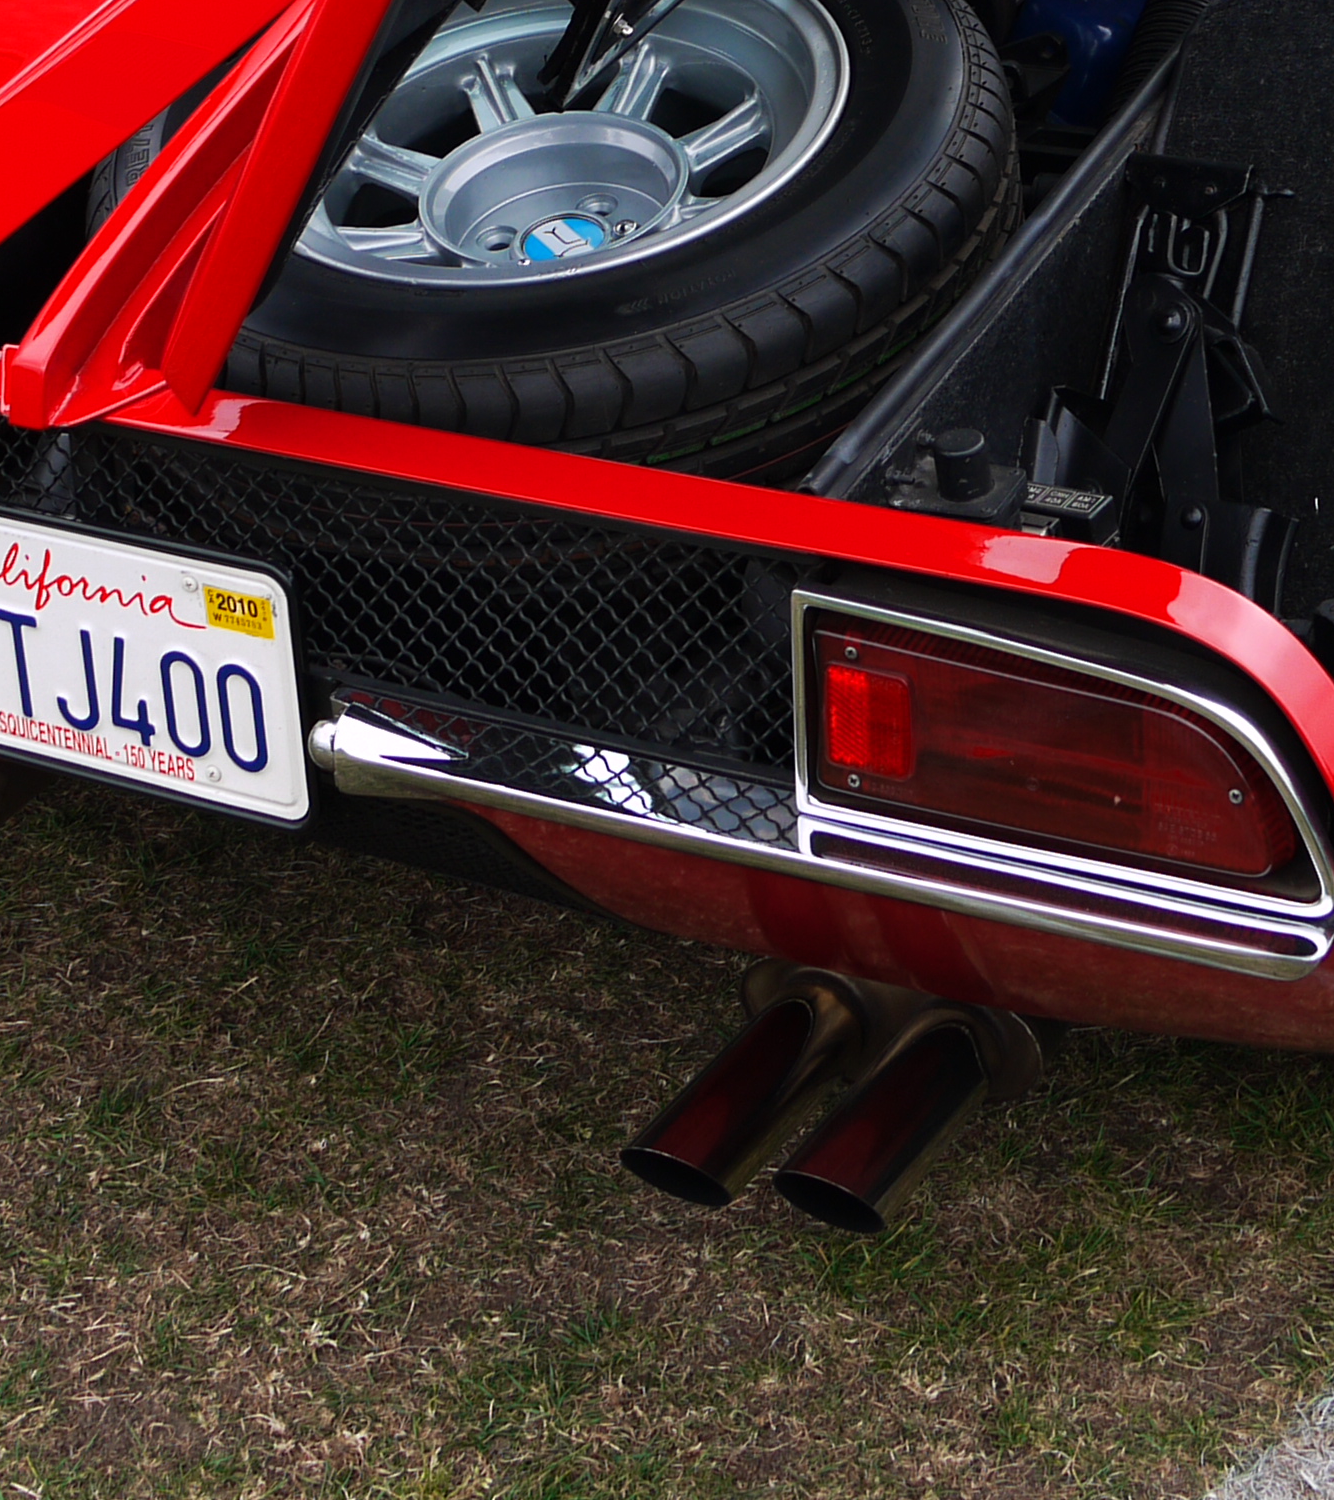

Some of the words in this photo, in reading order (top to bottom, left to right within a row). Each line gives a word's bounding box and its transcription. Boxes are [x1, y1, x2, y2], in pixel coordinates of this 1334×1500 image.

[216, 592, 258, 618] 2010
[123, 743, 146, 770] 150
[149, 749, 196, 782] YEARS
